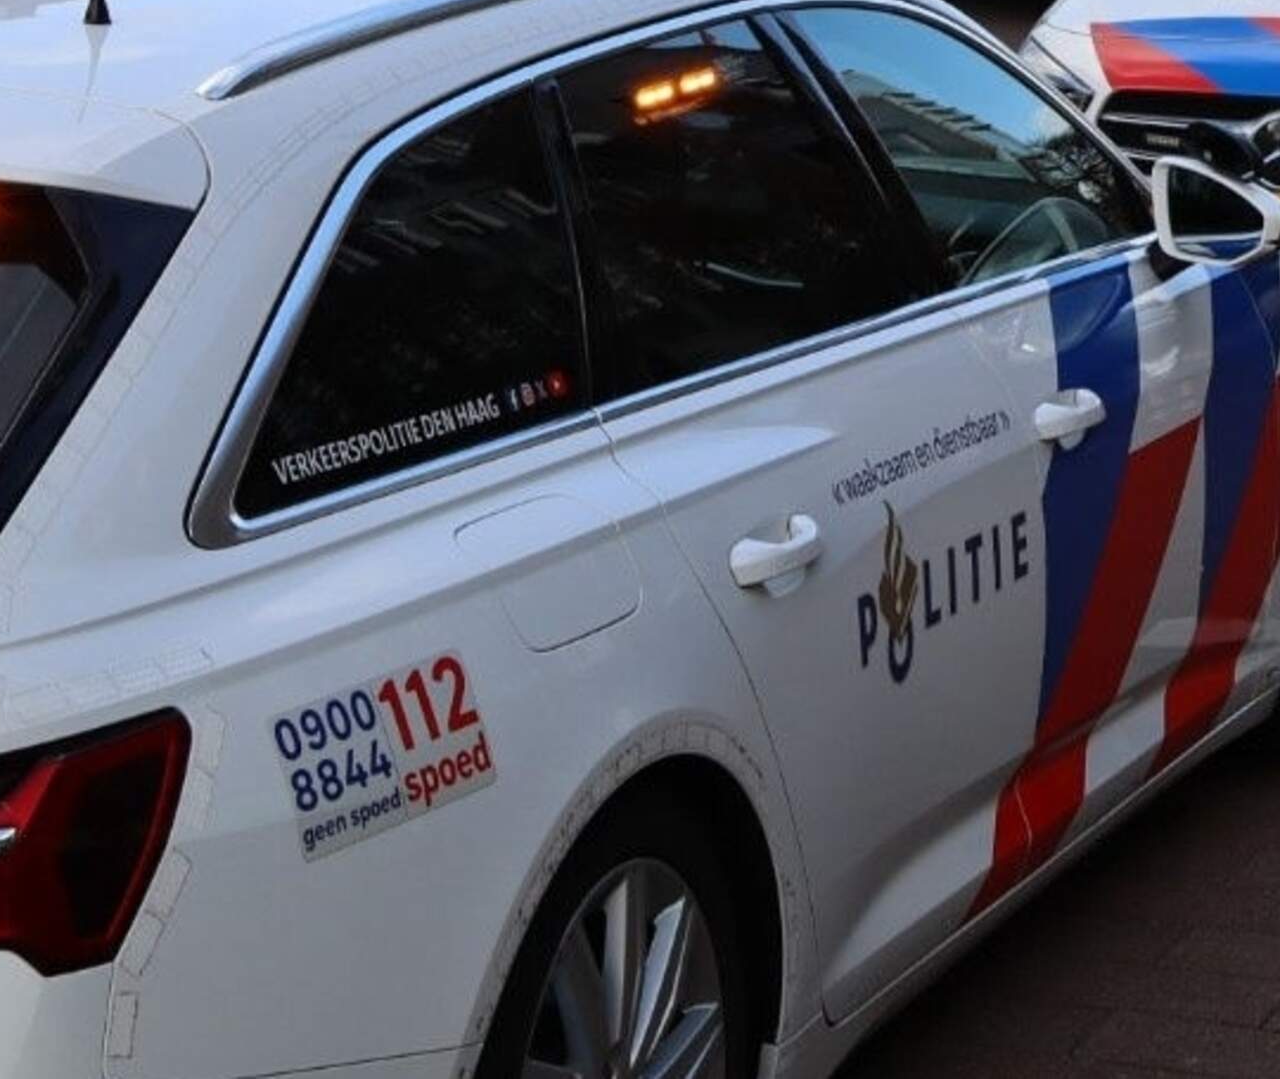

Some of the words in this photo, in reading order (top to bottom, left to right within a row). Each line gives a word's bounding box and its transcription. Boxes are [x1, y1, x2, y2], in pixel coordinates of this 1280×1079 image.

[271, 419, 421, 485] VERKEERSPOLITIE
[419, 406, 455, 439] DEN
[458, 393, 500, 429] HAAG
[857, 511, 1029, 684] POLITIE
[274, 690, 376, 760] 0900
[378, 656, 480, 751] 112
[291, 738, 391, 812] 8844
[404, 731, 492, 807] spoed
[303, 815, 348, 853] geen
[350, 787, 401, 829] spoed
